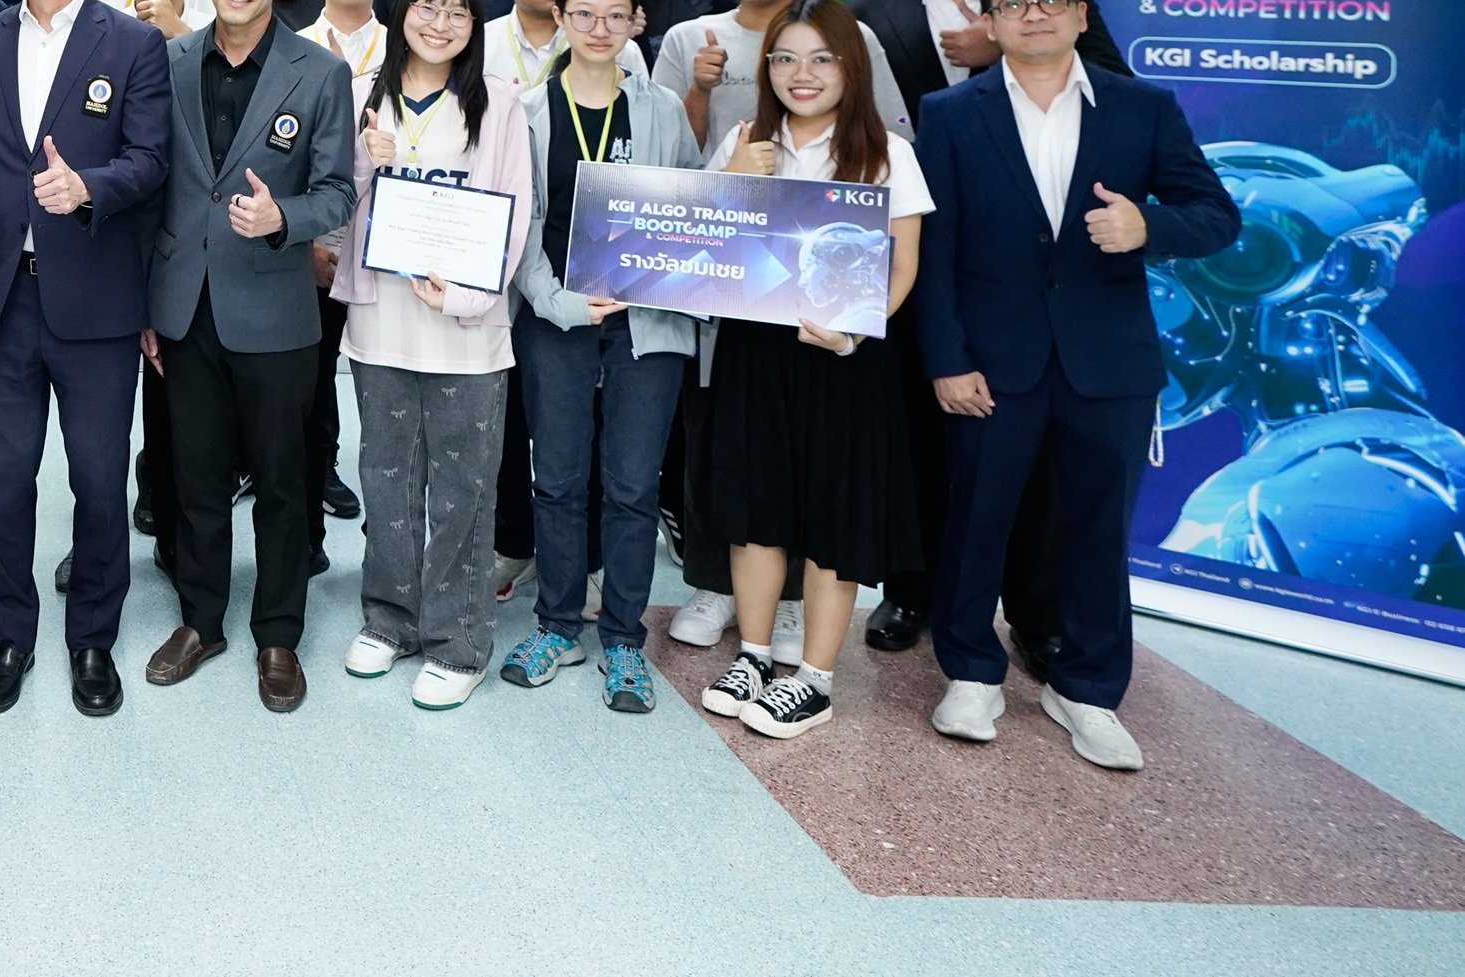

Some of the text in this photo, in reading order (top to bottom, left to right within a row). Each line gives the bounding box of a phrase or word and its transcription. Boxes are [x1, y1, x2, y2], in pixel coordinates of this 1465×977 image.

[1145, 47, 1377, 79] KGI Scholarship
[844, 189, 884, 208] KGI
[608, 199, 767, 226] KGI ALGO TRADING
[634, 217, 737, 239] BOOTCAMP
[656, 232, 723, 247] COMPETITION
[620, 252, 745, 279] รางวัลชมเชย
